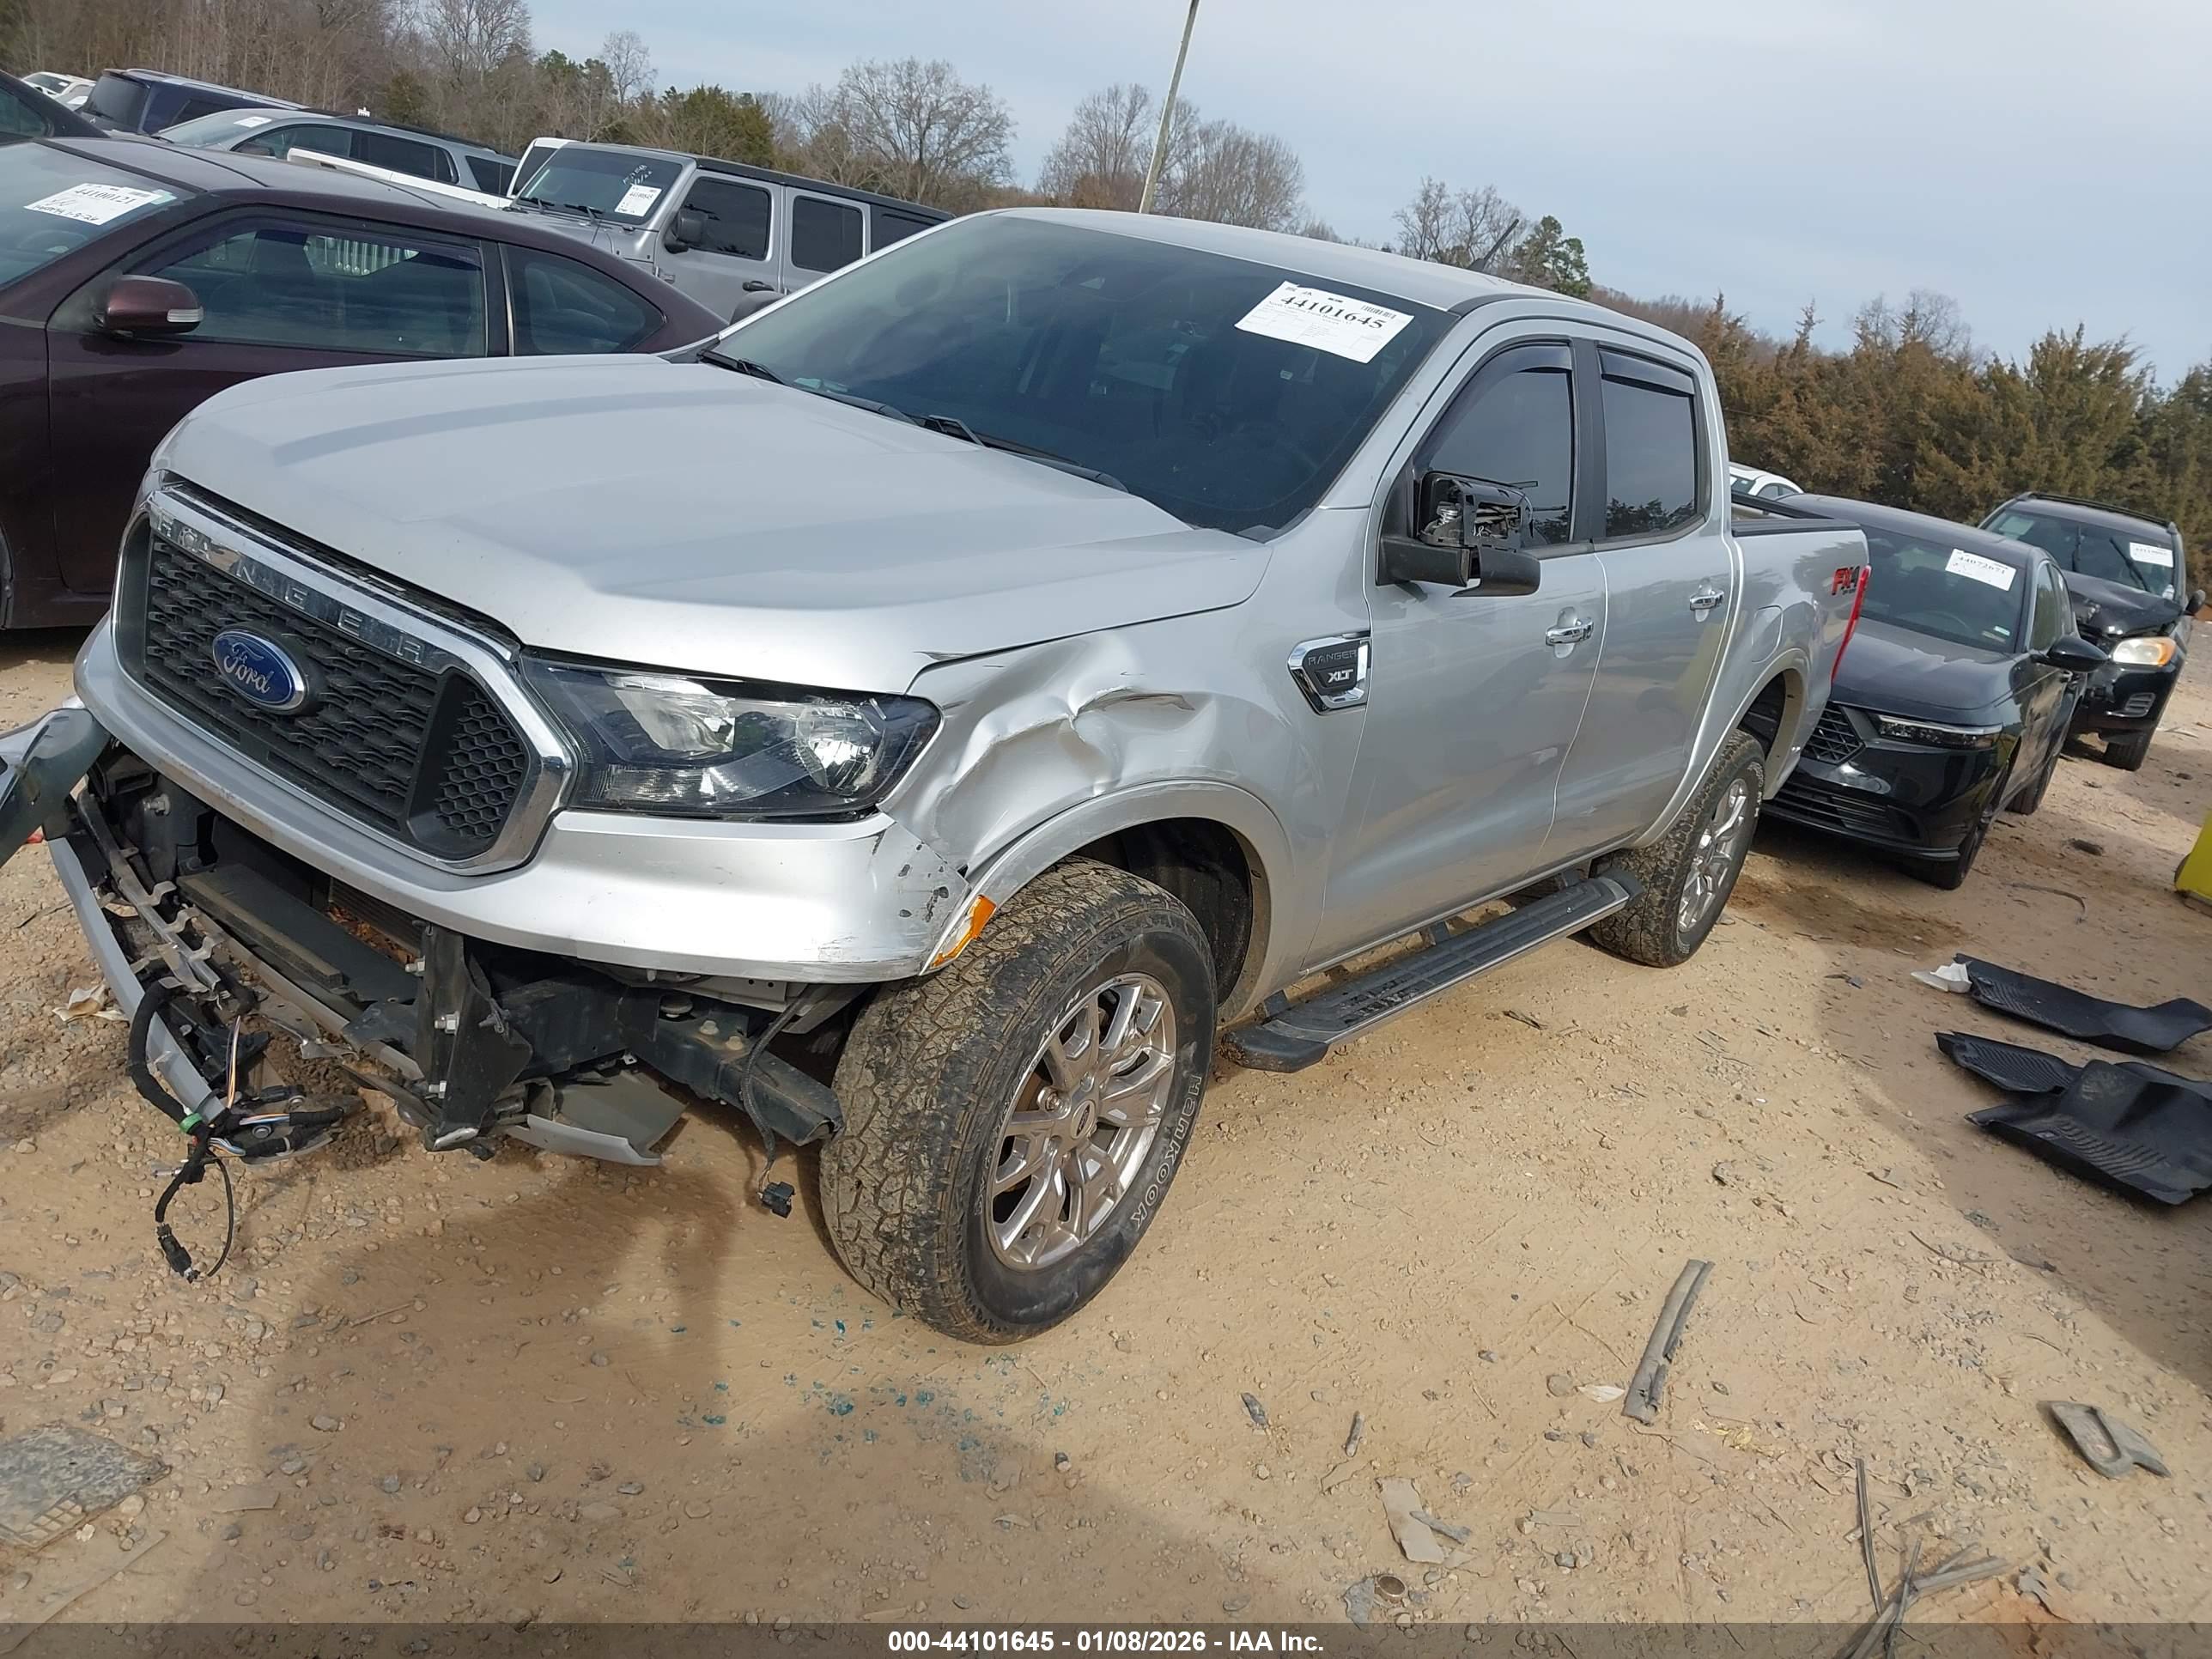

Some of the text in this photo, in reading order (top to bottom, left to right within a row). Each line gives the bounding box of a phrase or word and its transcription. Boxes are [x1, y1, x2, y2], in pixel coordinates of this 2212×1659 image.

[75, 188, 137, 205] 44100121
[1280, 295, 1387, 329] 44101645
[1832, 565, 1860, 595] FX4
[223, 641, 275, 694] Ford
[1308, 649, 1357, 666] RANGER
[1328, 669, 1354, 684] XLT
